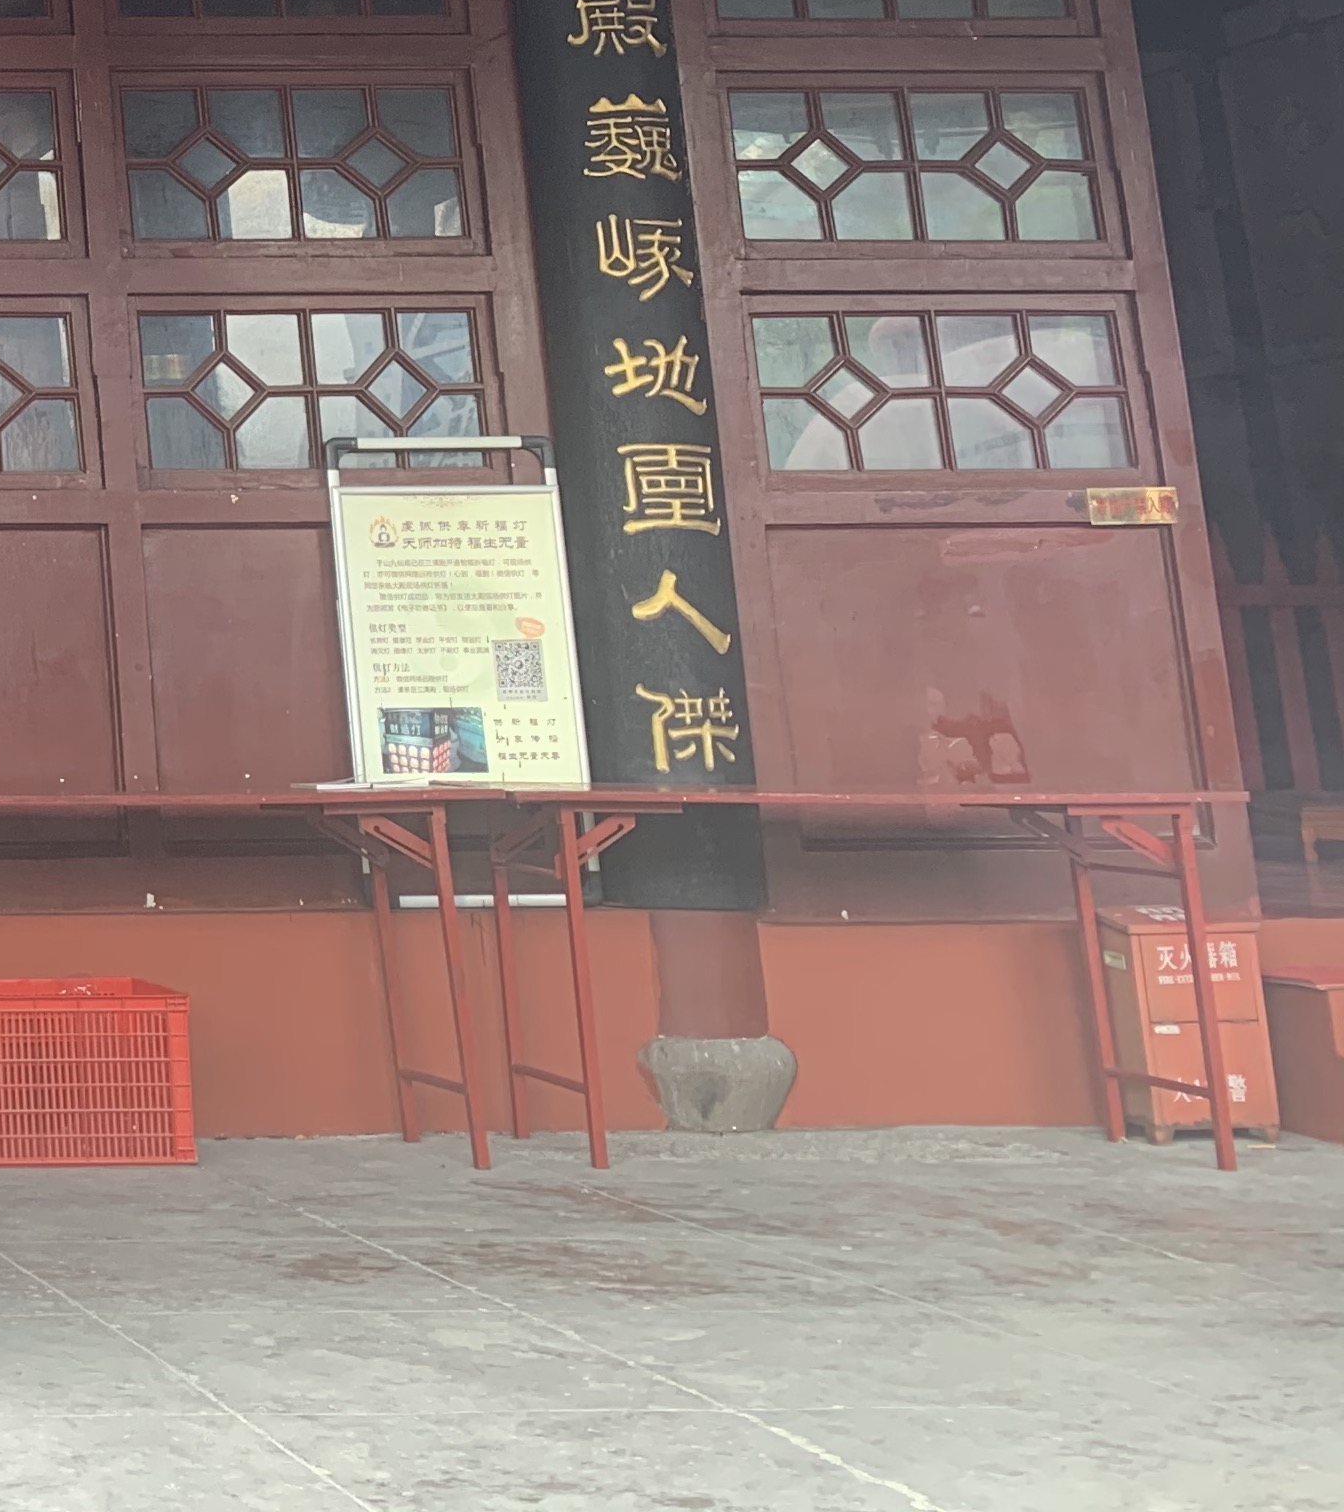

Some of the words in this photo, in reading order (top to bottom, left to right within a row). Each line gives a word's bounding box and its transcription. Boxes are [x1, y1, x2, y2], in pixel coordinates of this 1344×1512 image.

[401, 520, 528, 533] 虔诚供奉祈福灯
[402, 537, 462, 550] 天师加持
